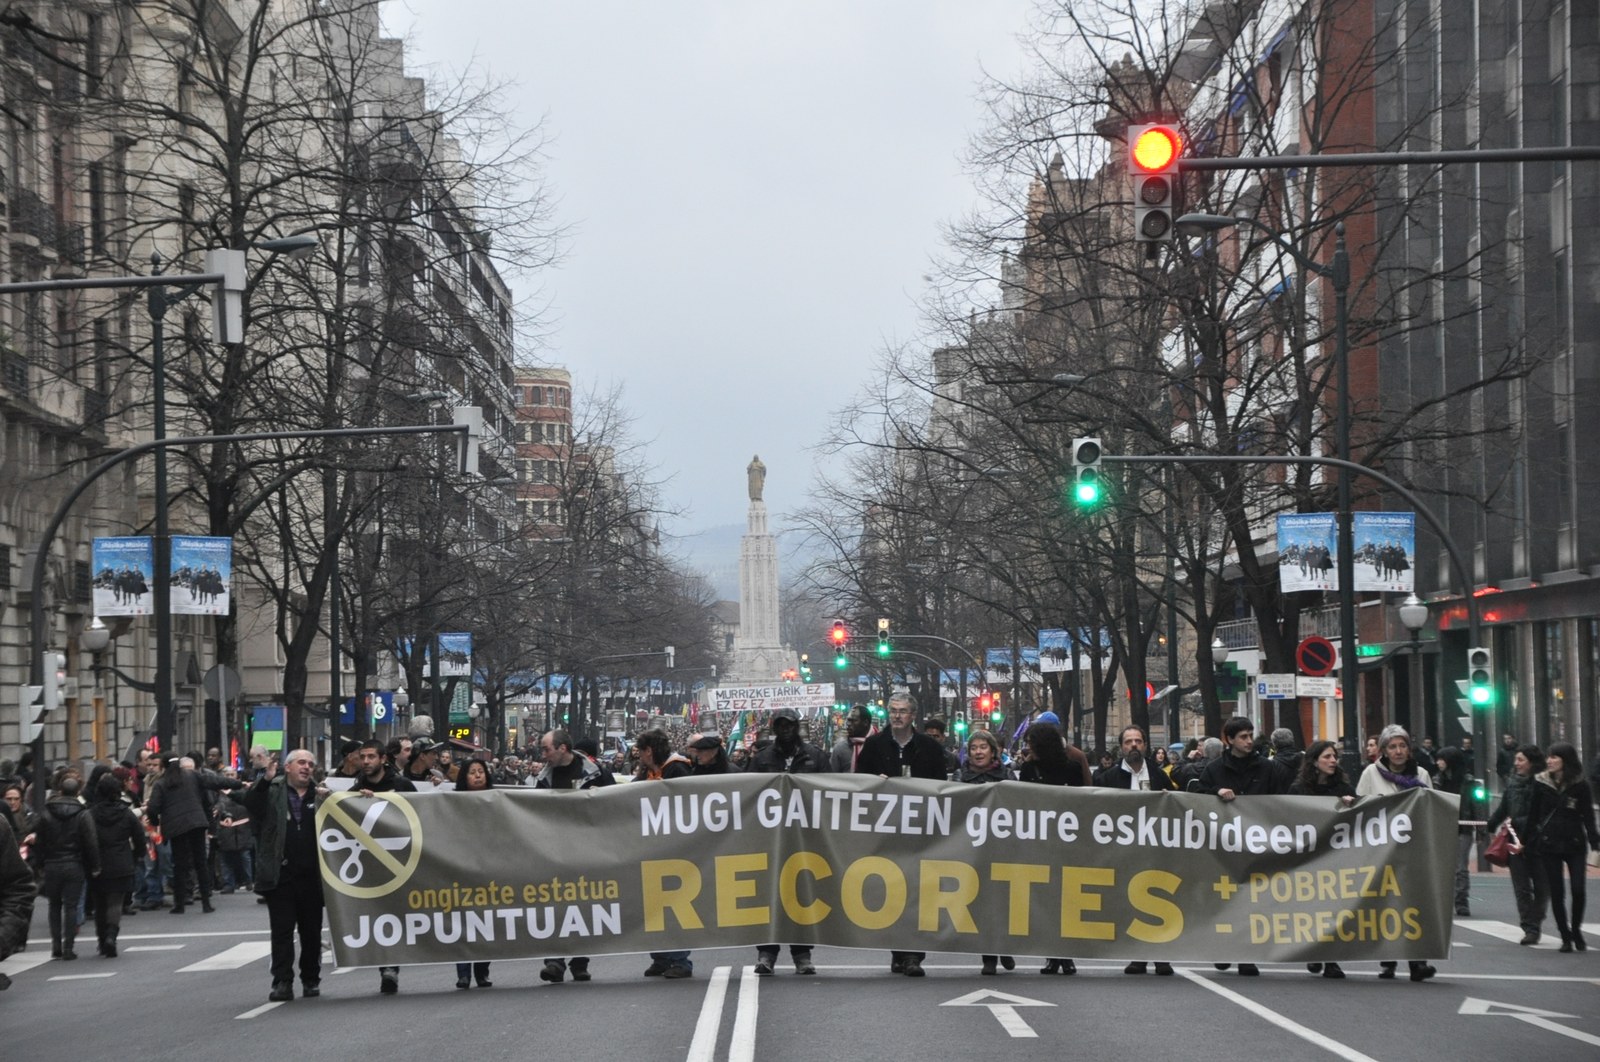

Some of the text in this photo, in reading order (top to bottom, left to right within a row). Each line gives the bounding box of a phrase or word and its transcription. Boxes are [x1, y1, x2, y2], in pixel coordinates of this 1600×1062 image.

[716, 686, 801, 700] MURRIZKETARIK
[806, 685, 822, 695] EZ
[716, 700, 731, 710] EZ
[733, 699, 747, 709] EZ
[751, 698, 765, 709] EZ
[640, 788, 1413, 854] MUGI GAITEZEN geure eskubideen alde
[408, 875, 619, 913] ongizate estatua
[640, 851, 1184, 944] RECORTES
[1250, 865, 1402, 903] POBREZA
[342, 902, 622, 949] JOPUNTUAN
[1250, 907, 1422, 945] DERECHOS
